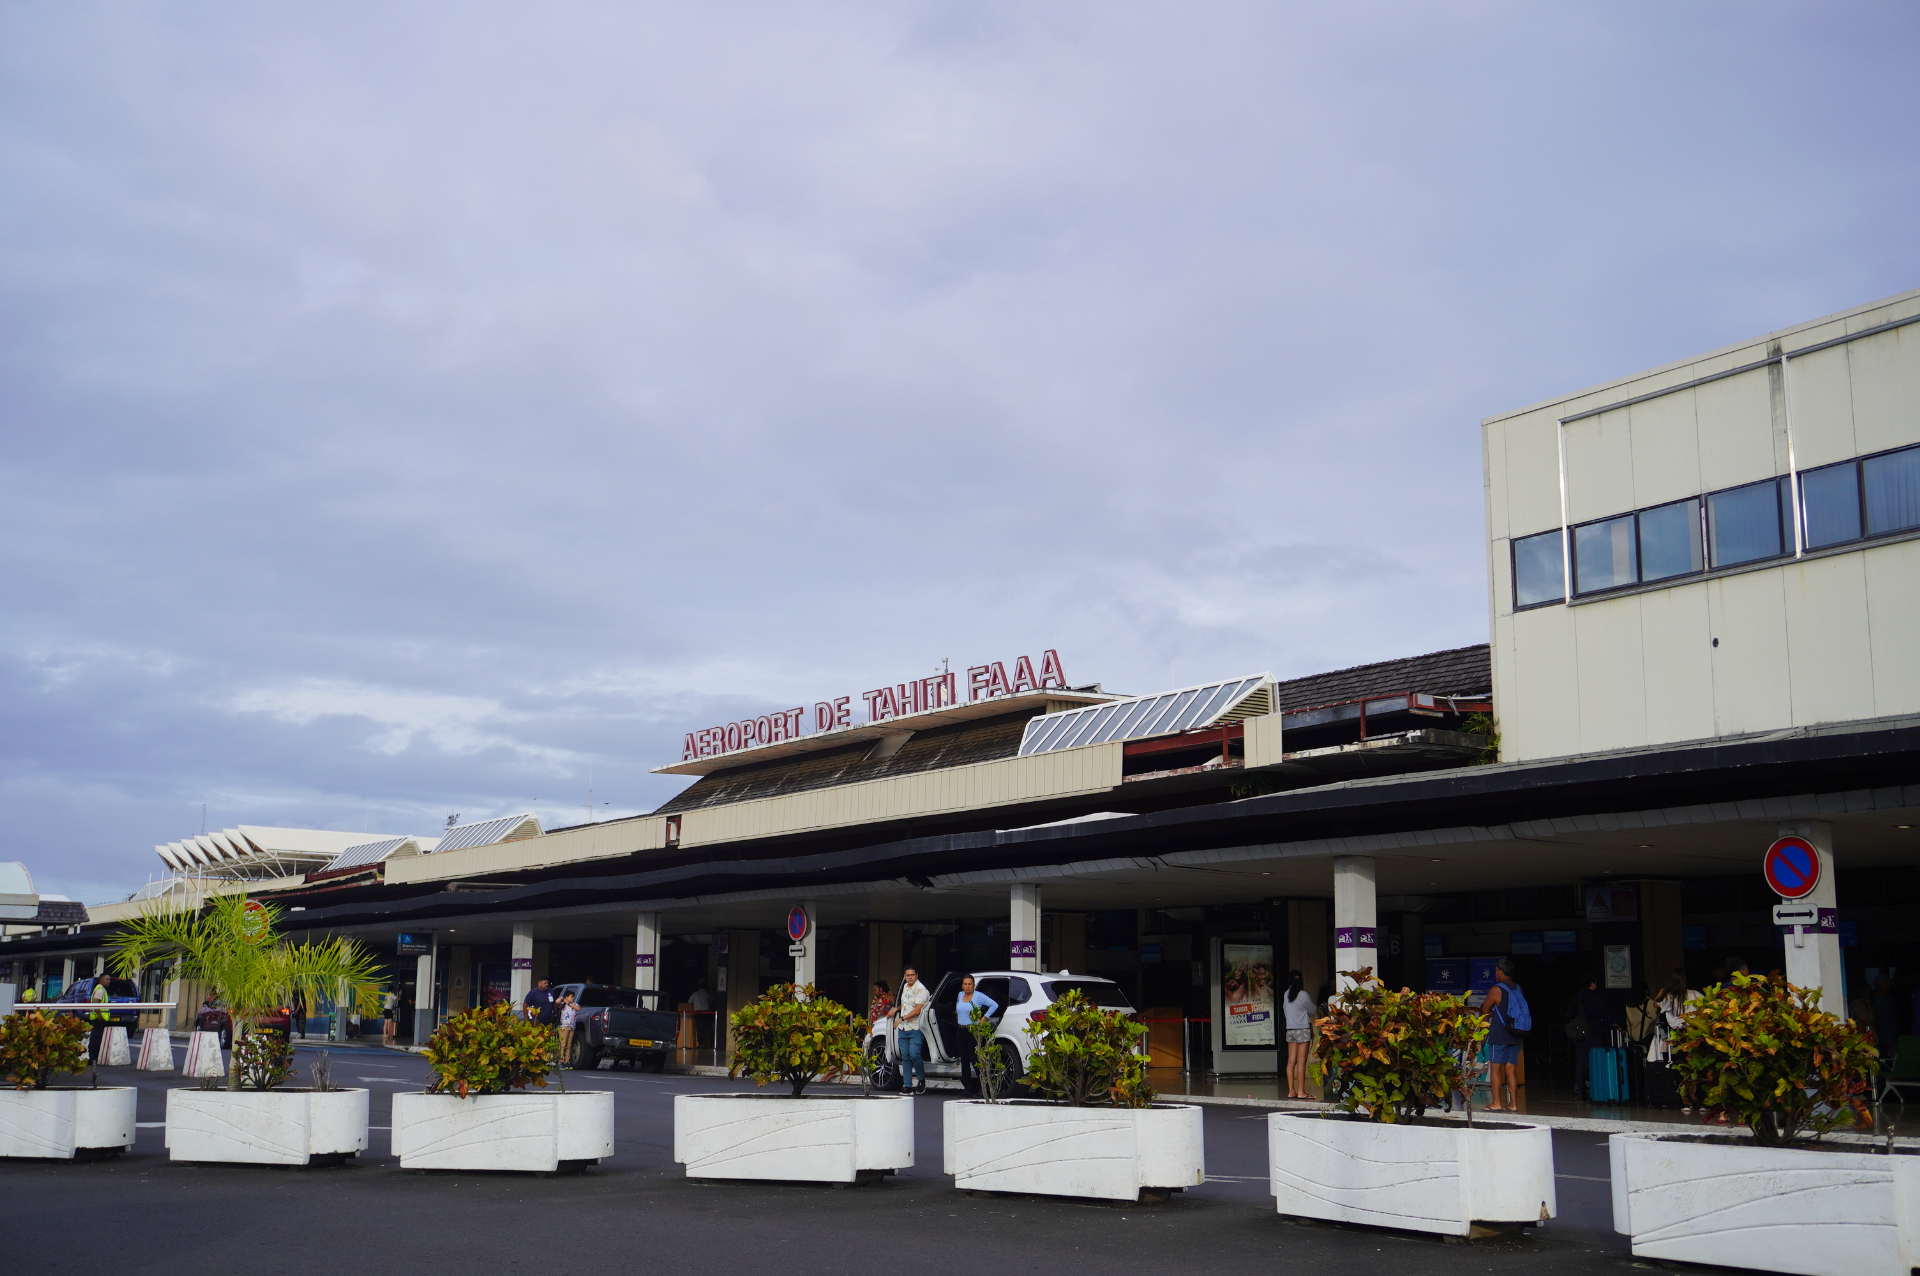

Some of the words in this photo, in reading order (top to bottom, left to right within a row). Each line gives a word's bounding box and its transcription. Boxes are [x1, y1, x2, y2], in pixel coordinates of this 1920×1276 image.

[682, 707, 804, 760] AEROPORT
[815, 696, 851, 734] DE
[863, 673, 956, 723] TAHITI
[967, 649, 1067, 702] FAAA
[1390, 940, 1400, 955] B
